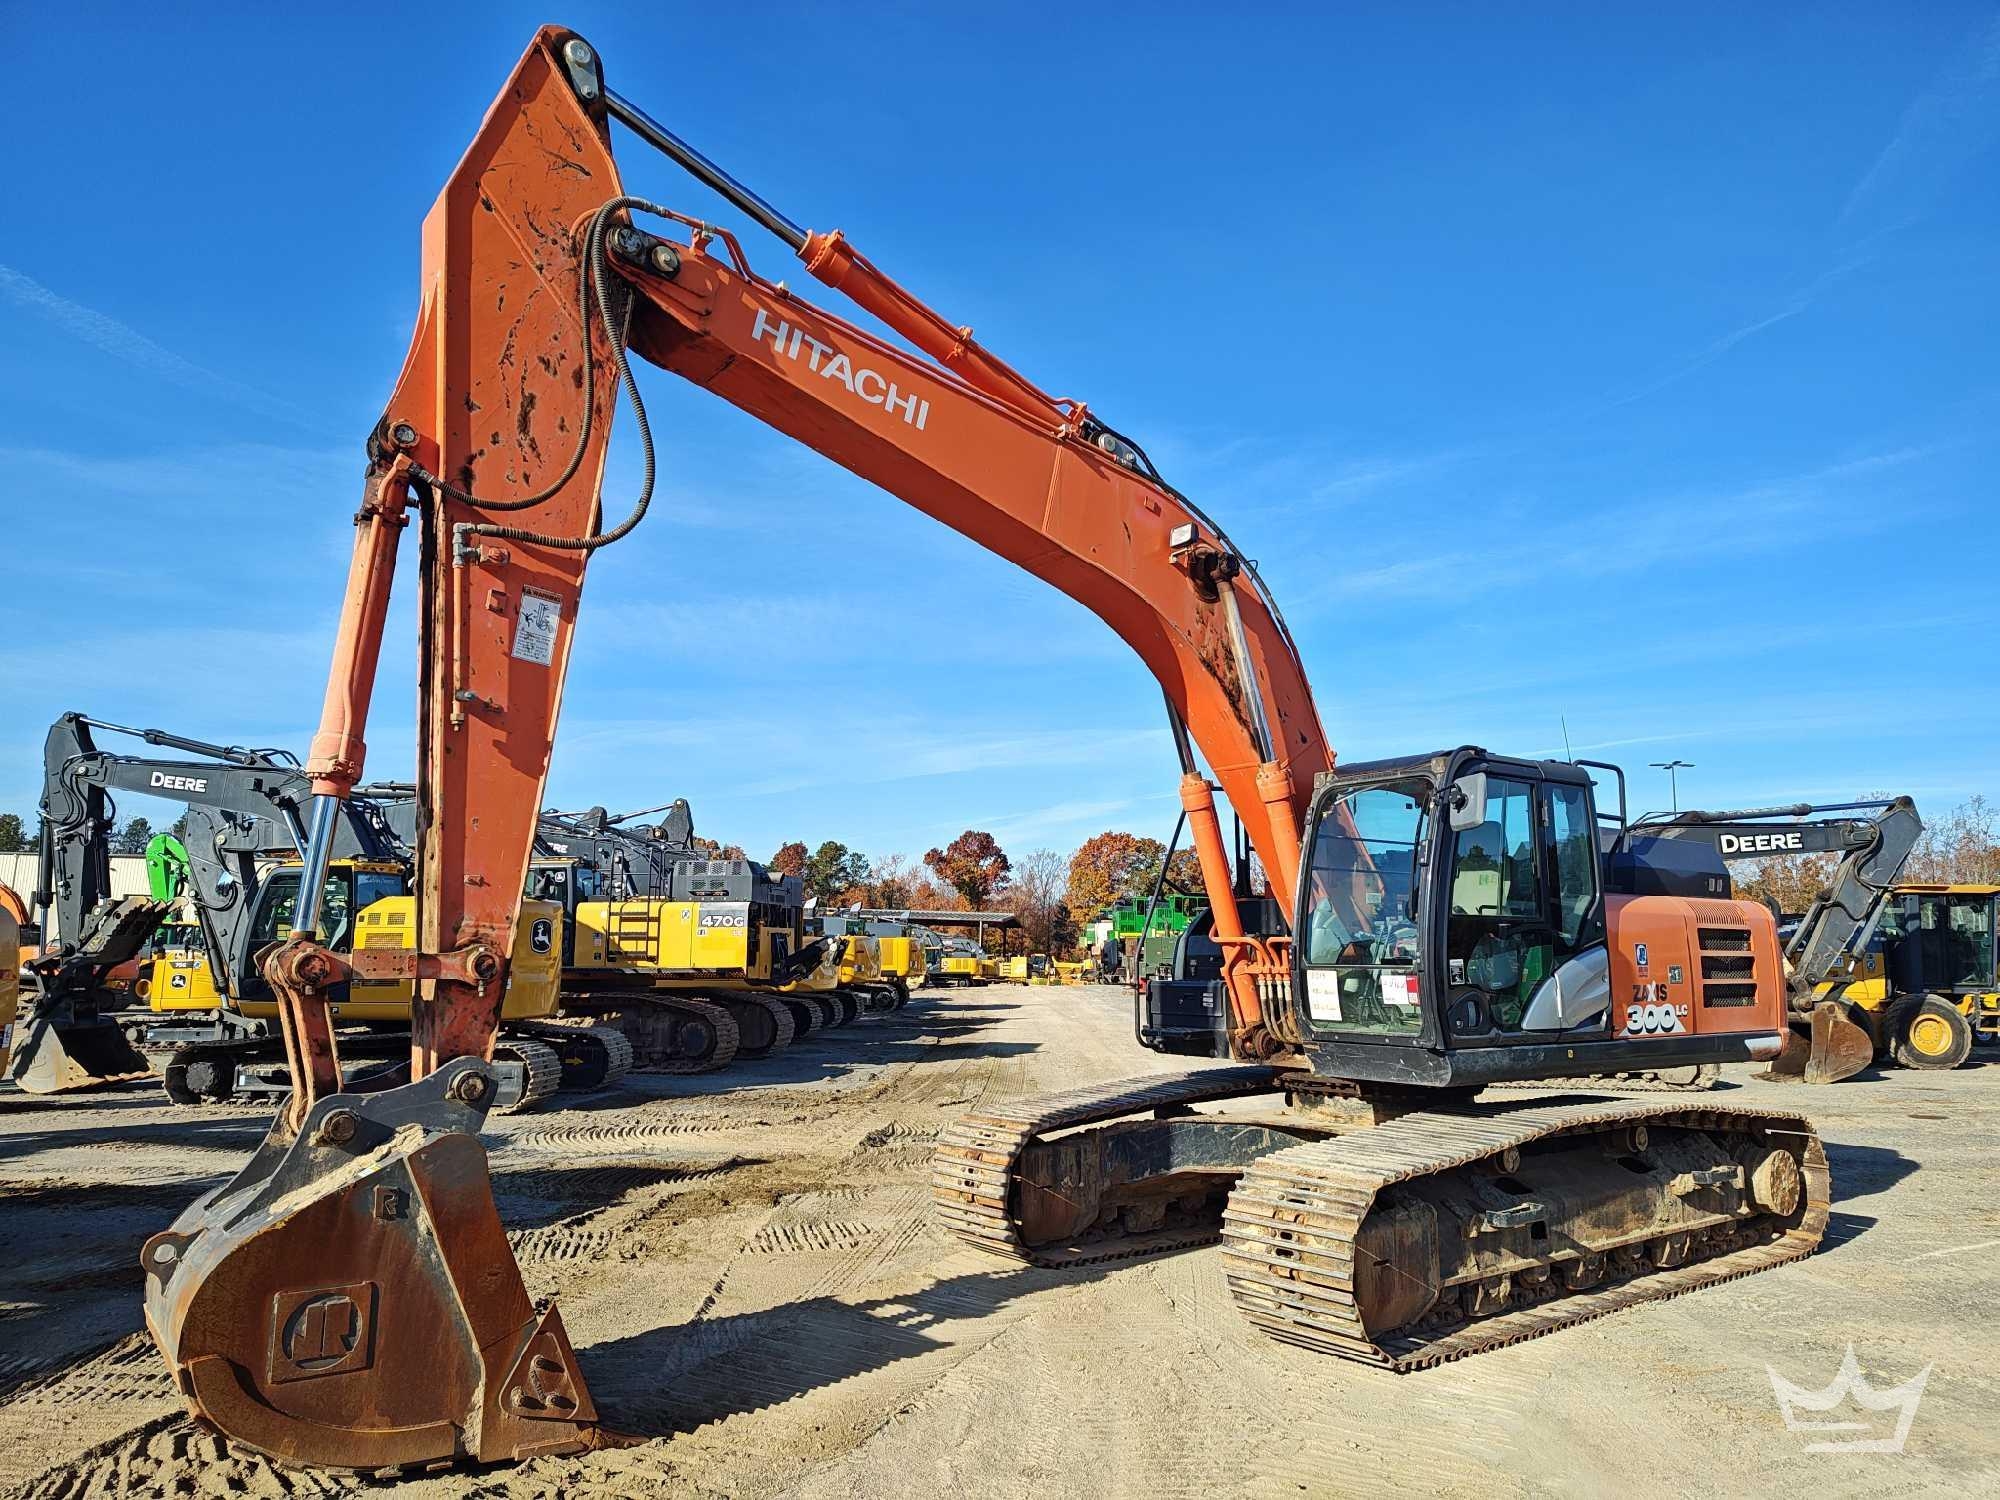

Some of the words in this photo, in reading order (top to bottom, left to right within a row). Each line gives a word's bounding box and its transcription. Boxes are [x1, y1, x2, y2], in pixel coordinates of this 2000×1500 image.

[751, 307, 930, 431] HITACHI
[150, 771, 208, 793] DEERE
[1720, 832, 1803, 854] DEERE
[701, 915, 744, 927] 470G
[1632, 980, 1668, 1002] ZAXIS
